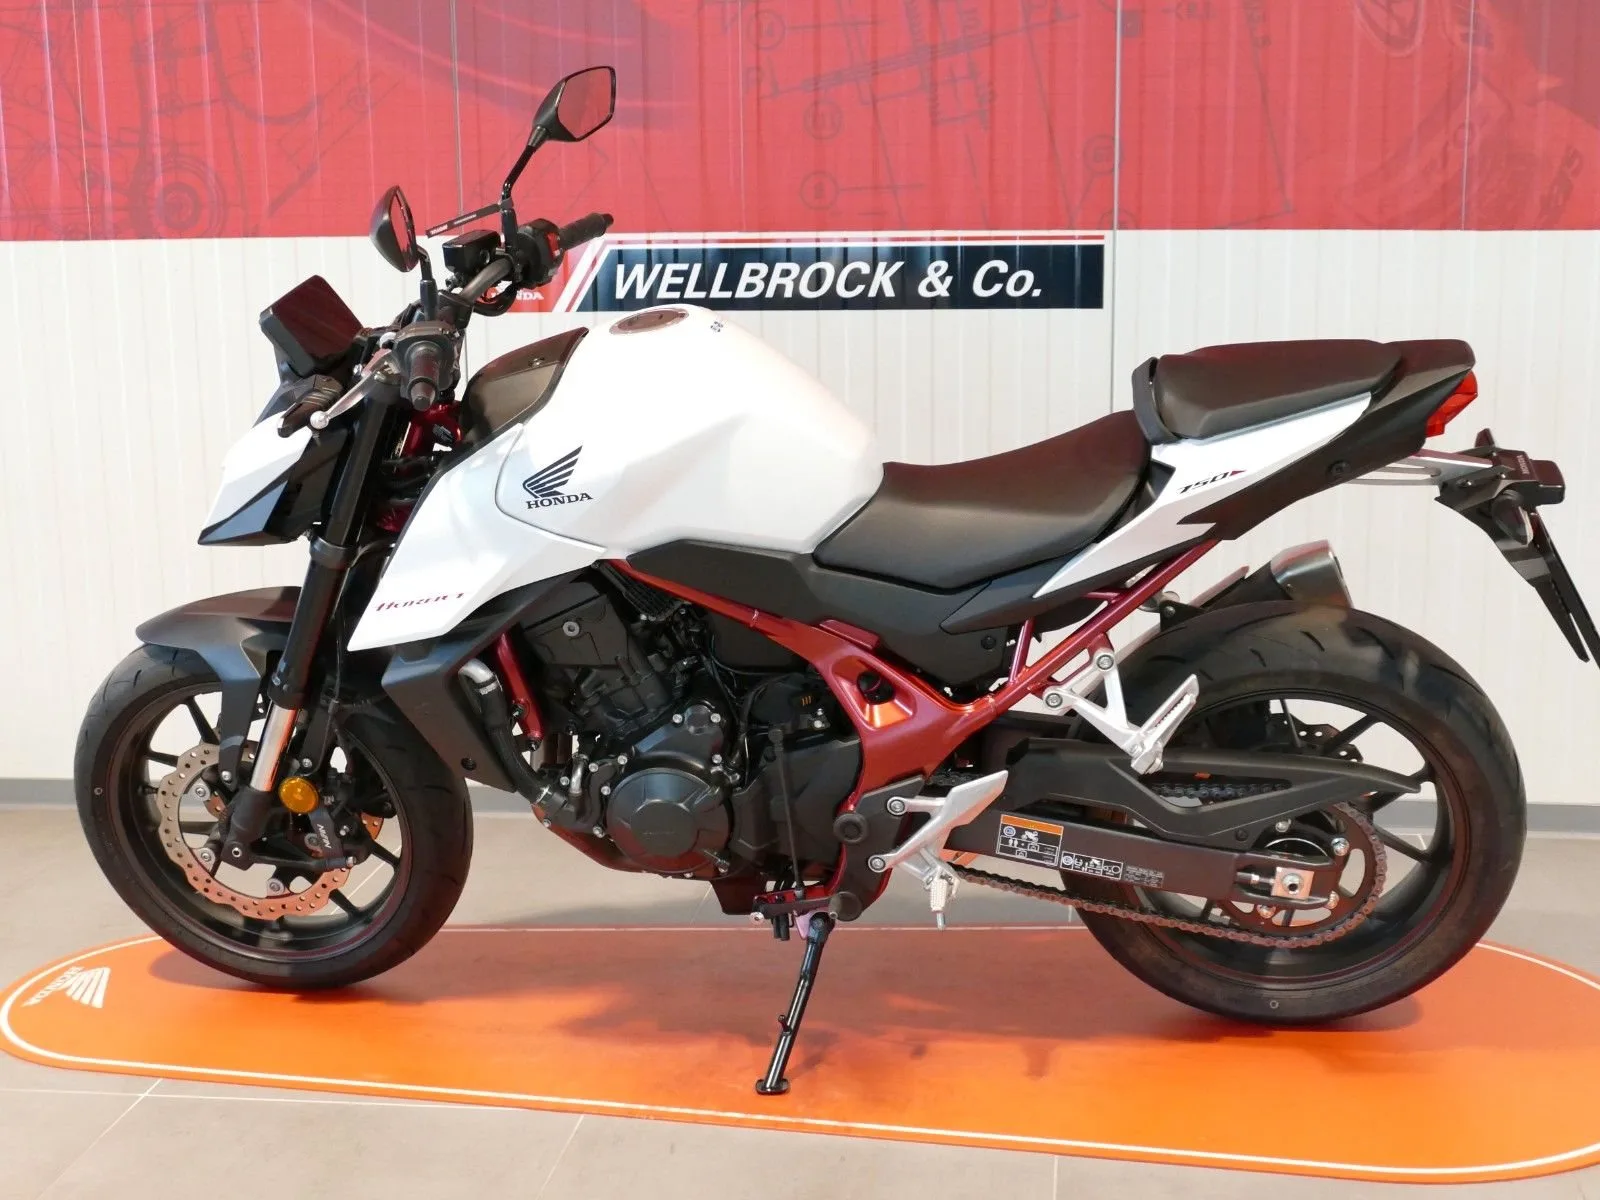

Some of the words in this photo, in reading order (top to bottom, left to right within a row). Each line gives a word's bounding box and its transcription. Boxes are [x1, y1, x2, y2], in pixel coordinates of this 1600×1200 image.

[615, 261, 905, 299] WELLBROCK
[917, 260, 953, 298] &
[972, 259, 1042, 297] Co.
[1177, 471, 1230, 495] 750
[526, 492, 594, 509] HONDA
